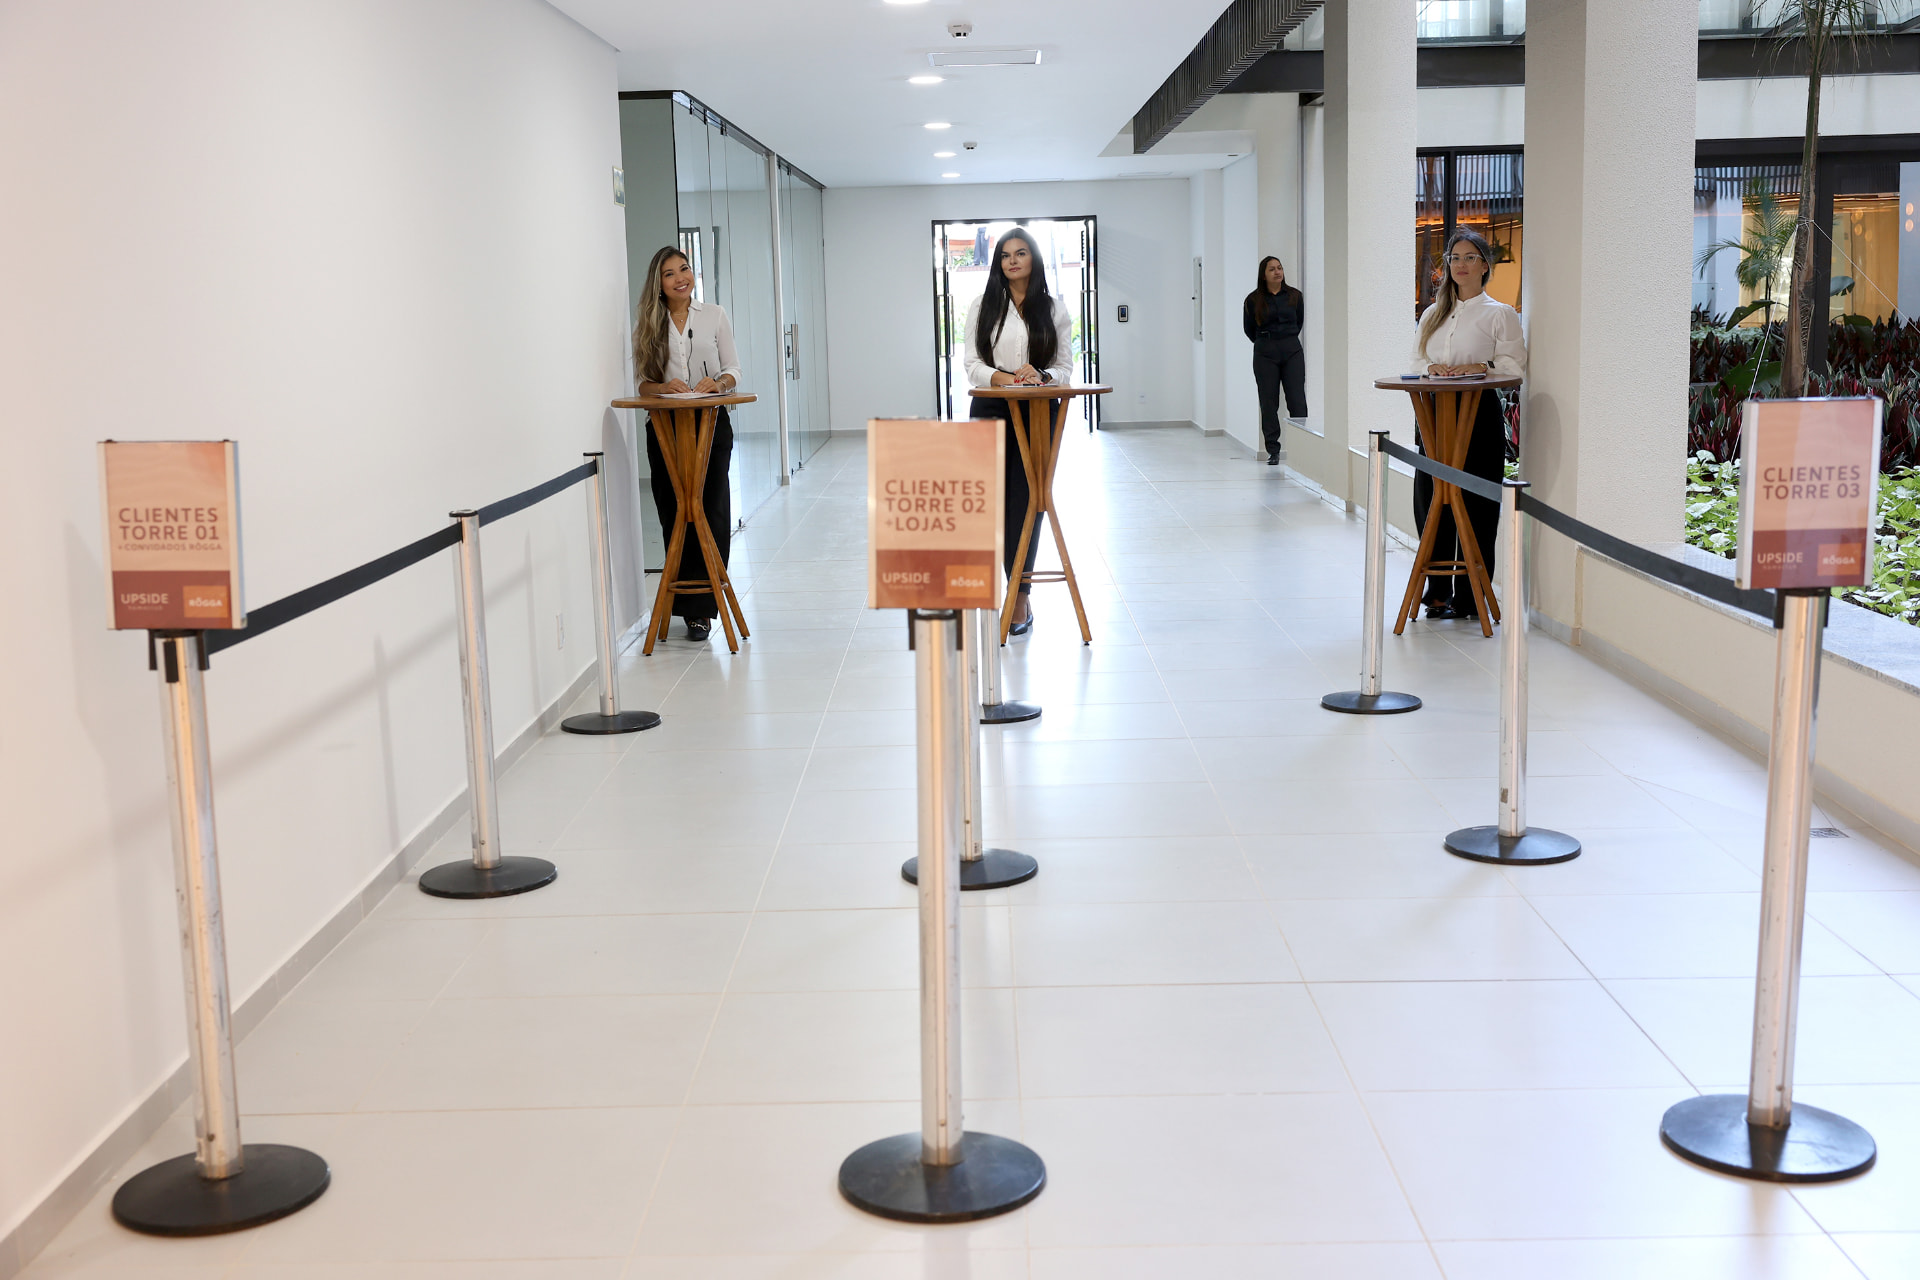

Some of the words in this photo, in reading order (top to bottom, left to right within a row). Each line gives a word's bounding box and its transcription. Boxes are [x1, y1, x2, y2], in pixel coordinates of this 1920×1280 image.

[1763, 465, 1861, 483] CLIENTES
[885, 479, 986, 496] CLIENTES
[1762, 484, 1830, 500] TORRE
[1837, 482, 1861, 499] 03
[885, 497, 955, 513] TORRE
[961, 497, 986, 514] 02
[118, 507, 219, 523] CLIENTES
[118, 525, 189, 540] TORRE
[195, 525, 220, 540] 01
[1757, 552, 1804, 564] UPSIDE
[882, 572, 932, 584] UPSIDE
[121, 593, 169, 605] UPSIDE
